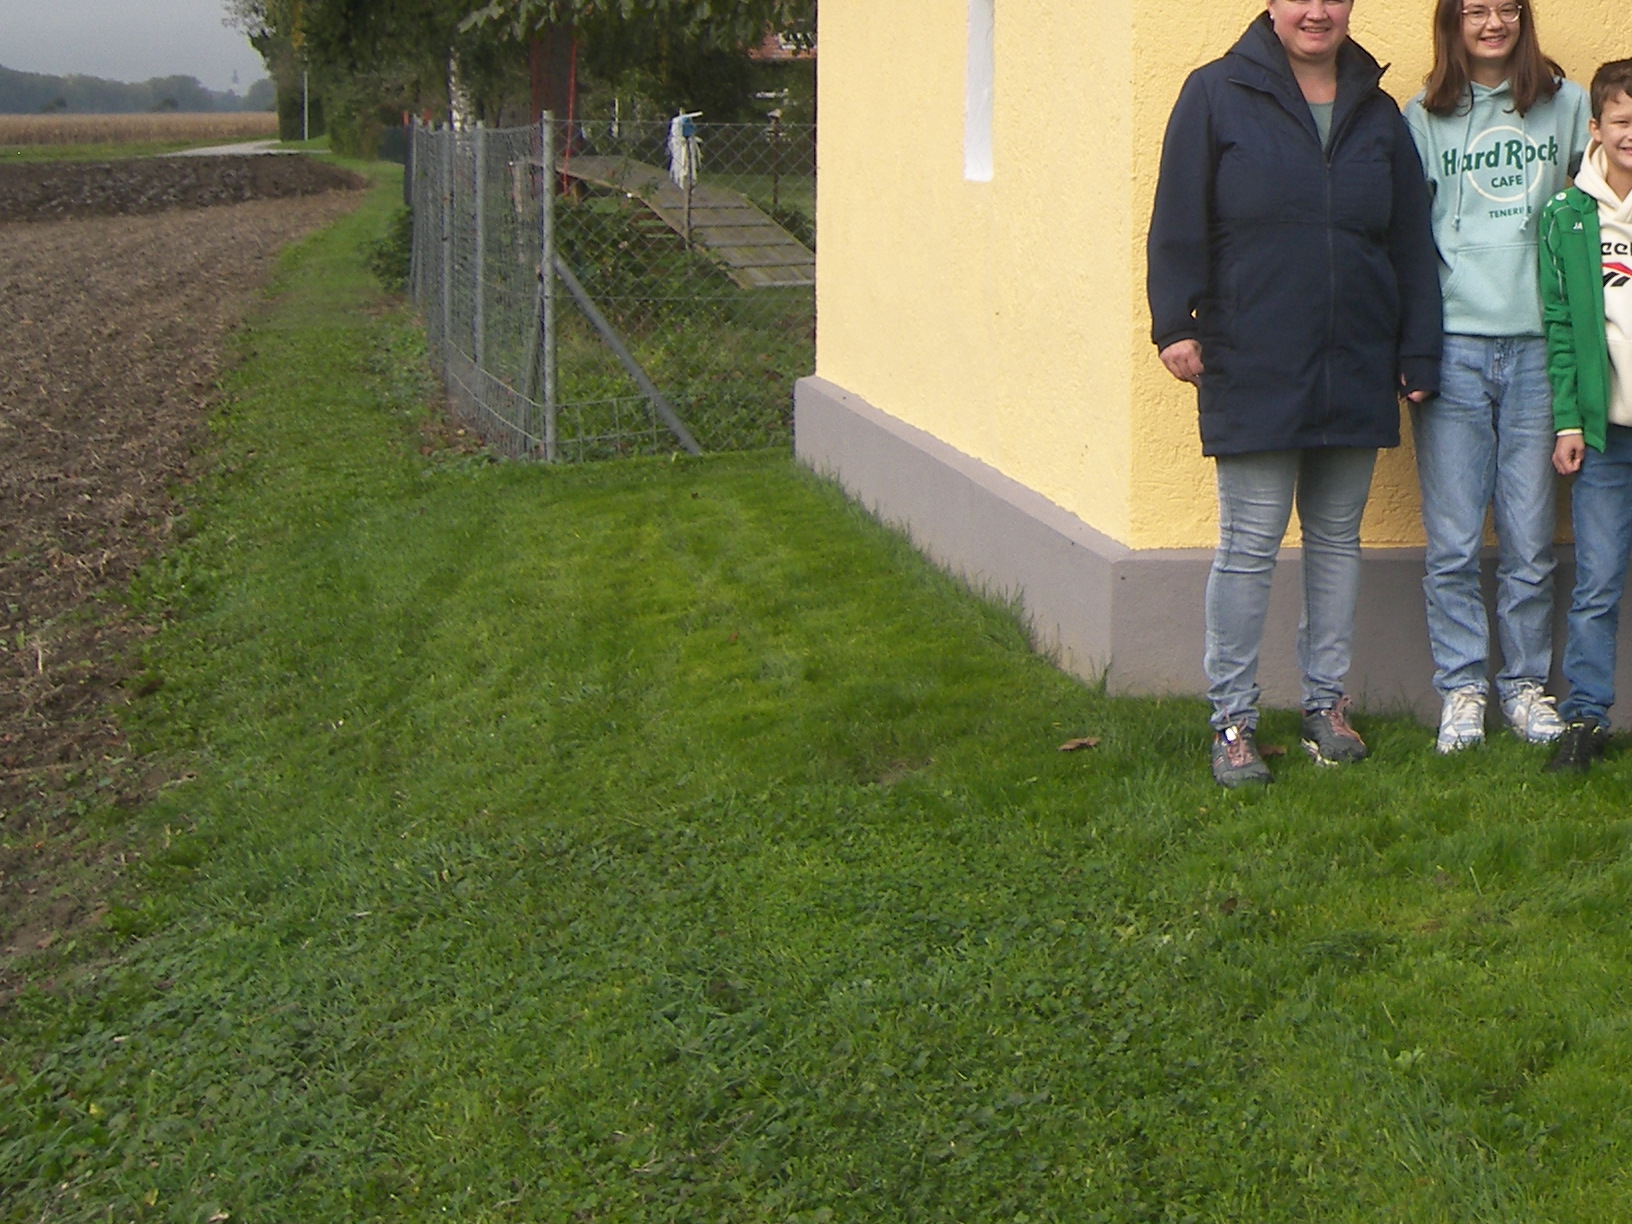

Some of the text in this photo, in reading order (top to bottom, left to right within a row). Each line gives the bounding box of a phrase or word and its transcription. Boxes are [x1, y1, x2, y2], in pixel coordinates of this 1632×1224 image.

[1442, 136, 1558, 177] Hard Rock
[1491, 175, 1523, 189] CAFE
[1488, 206, 1532, 218] TENERIE
